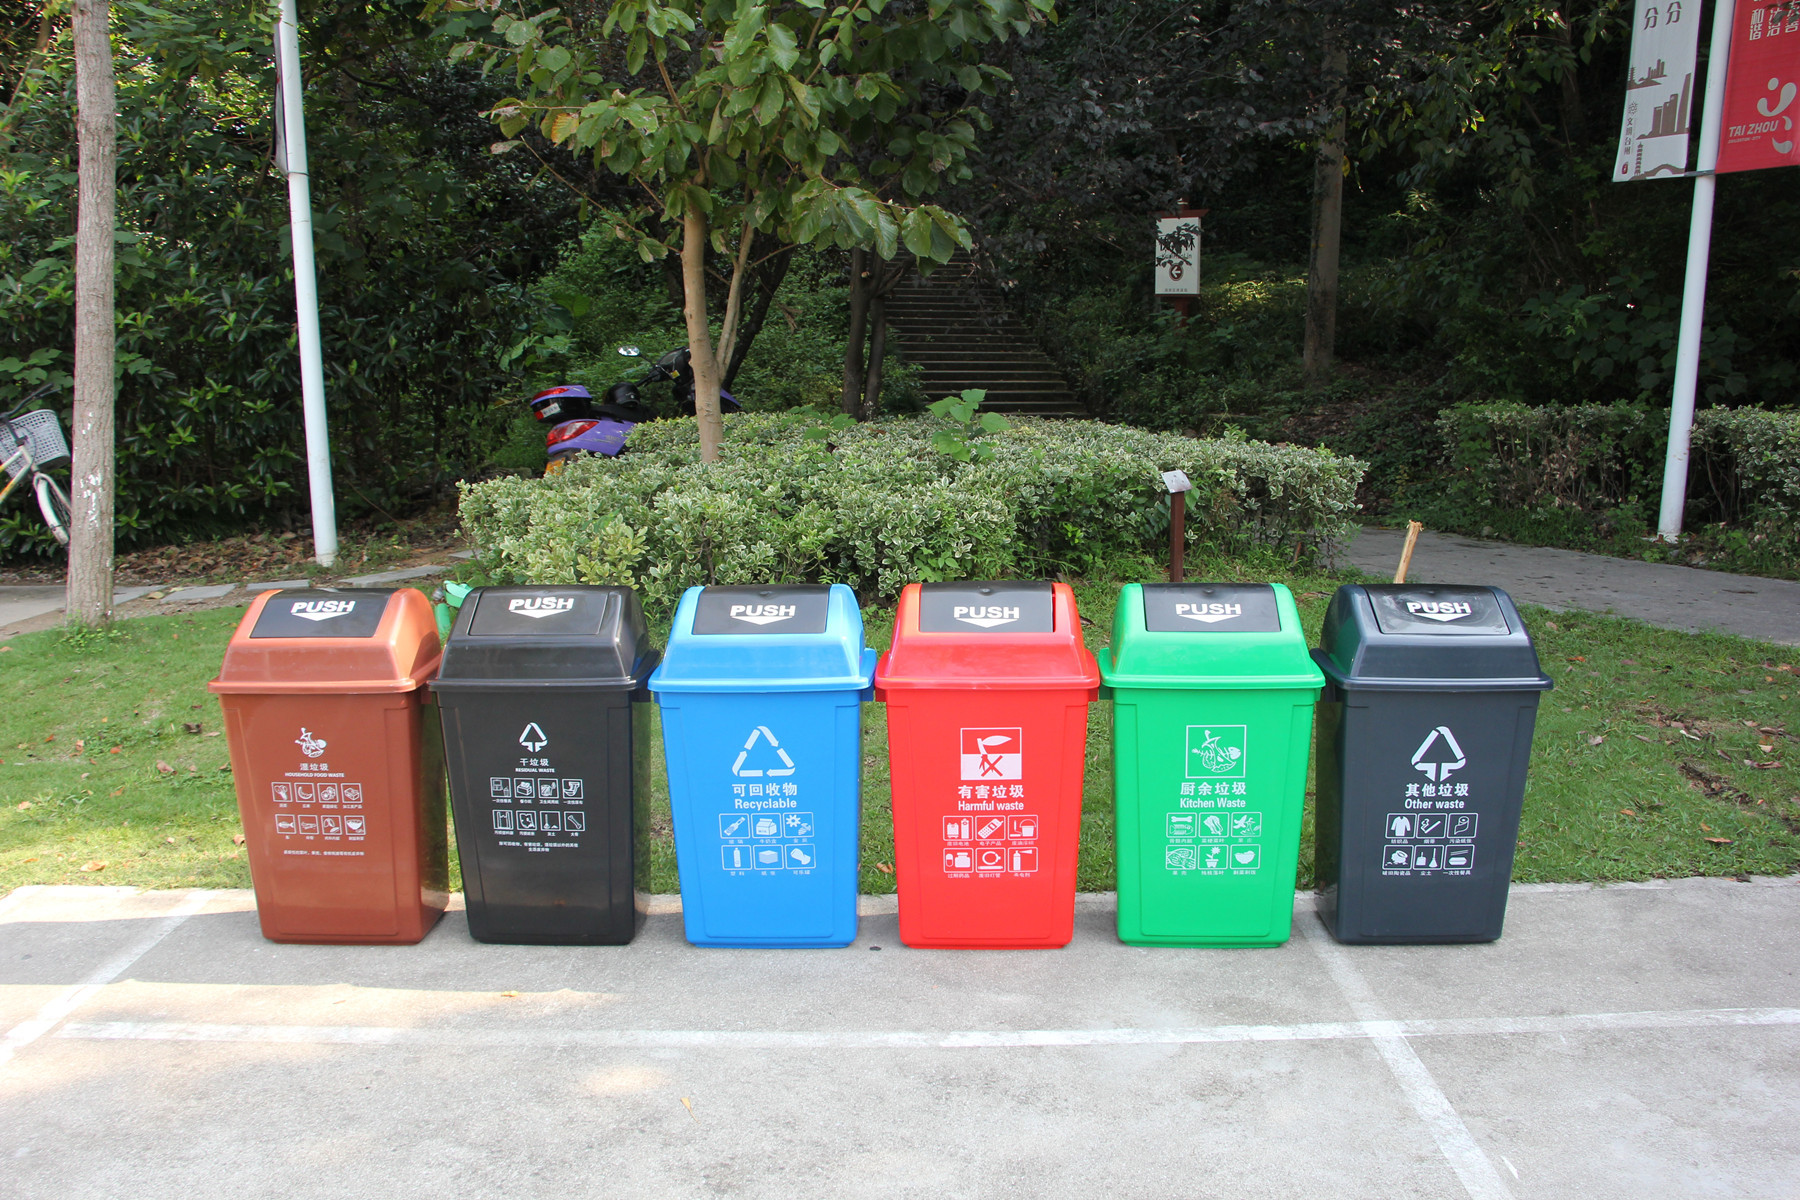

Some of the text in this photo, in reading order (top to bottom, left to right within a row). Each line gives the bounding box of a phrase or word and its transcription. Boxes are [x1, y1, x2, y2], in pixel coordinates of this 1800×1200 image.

[1729, 120, 1779, 138] TAI ZHOU
[291, 601, 355, 614] PUSH
[509, 597, 574, 611] PUSH
[1176, 604, 1241, 616] PUSH
[1407, 601, 1471, 615] PUSH
[731, 605, 795, 618] PUSH
[954, 607, 1019, 620] PUSH
[520, 758, 549, 766] 干垃圾
[732, 783, 797, 797] 可回收物
[958, 785, 1024, 799] 有害垃圾
[1180, 782, 1246, 795] 厨余垃圾
[1406, 783, 1468, 797] 其他垃圾
[734, 798, 797, 811] Recyclable
[958, 801, 1024, 810] Harmful waste
[1180, 798, 1246, 808] Kitchen Waste
[1405, 799, 1464, 809] Other waste
